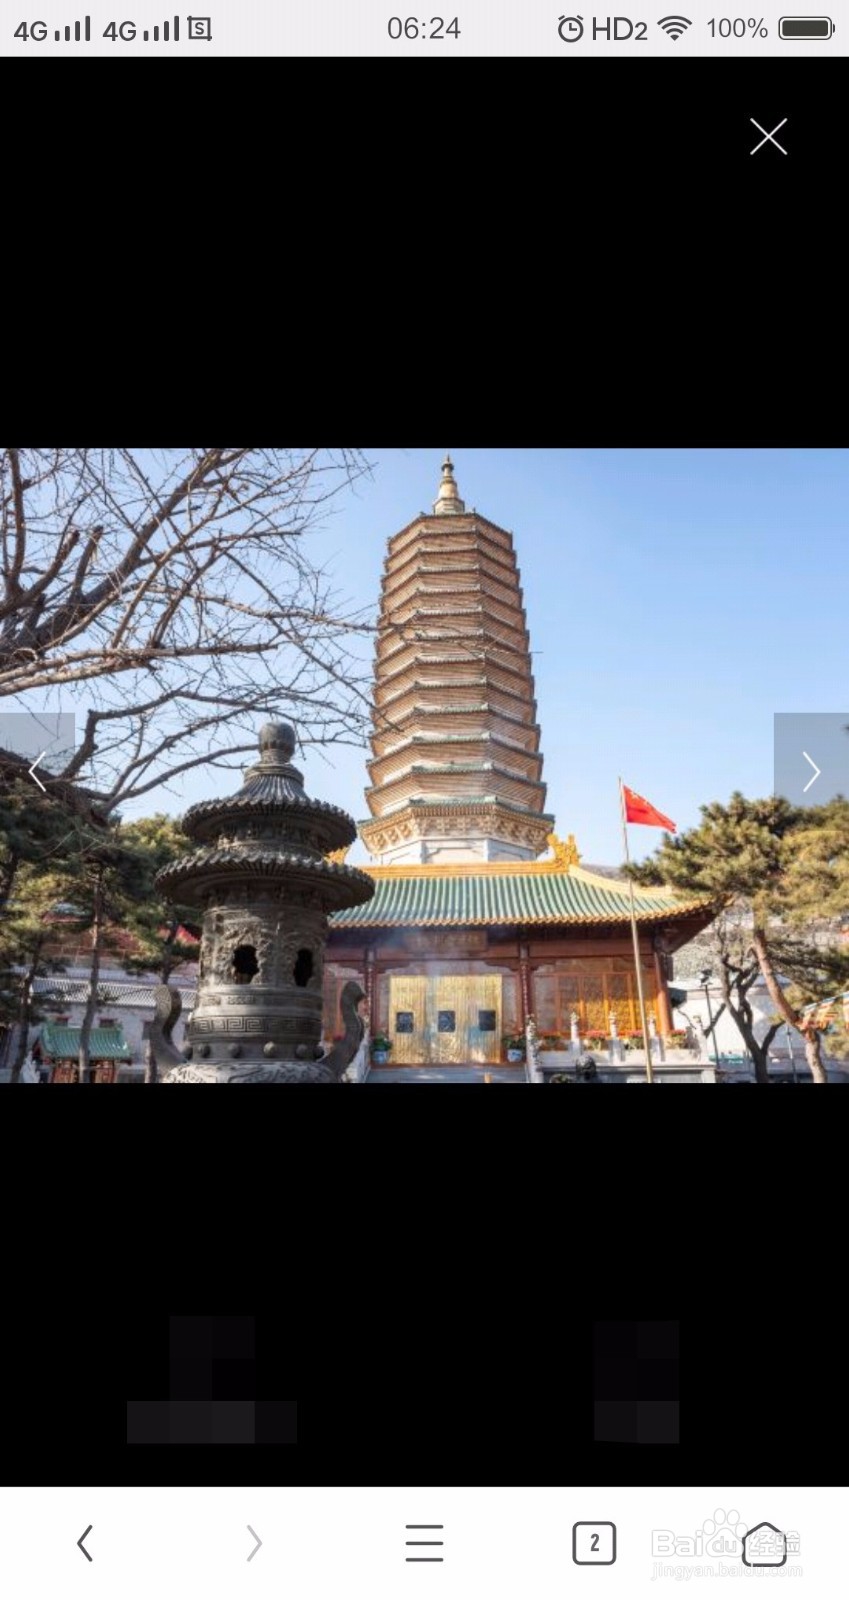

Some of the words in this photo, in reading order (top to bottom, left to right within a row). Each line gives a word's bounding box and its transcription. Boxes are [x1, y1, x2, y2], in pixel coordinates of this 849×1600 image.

[13, 20, 48, 42] 4G
[102, 20, 137, 42] 4G
[387, 16, 462, 40] 06:24
[592, 16, 648, 41] HD2
[707, 17, 769, 39] 100%
[590, 1533, 600, 1552] 2
